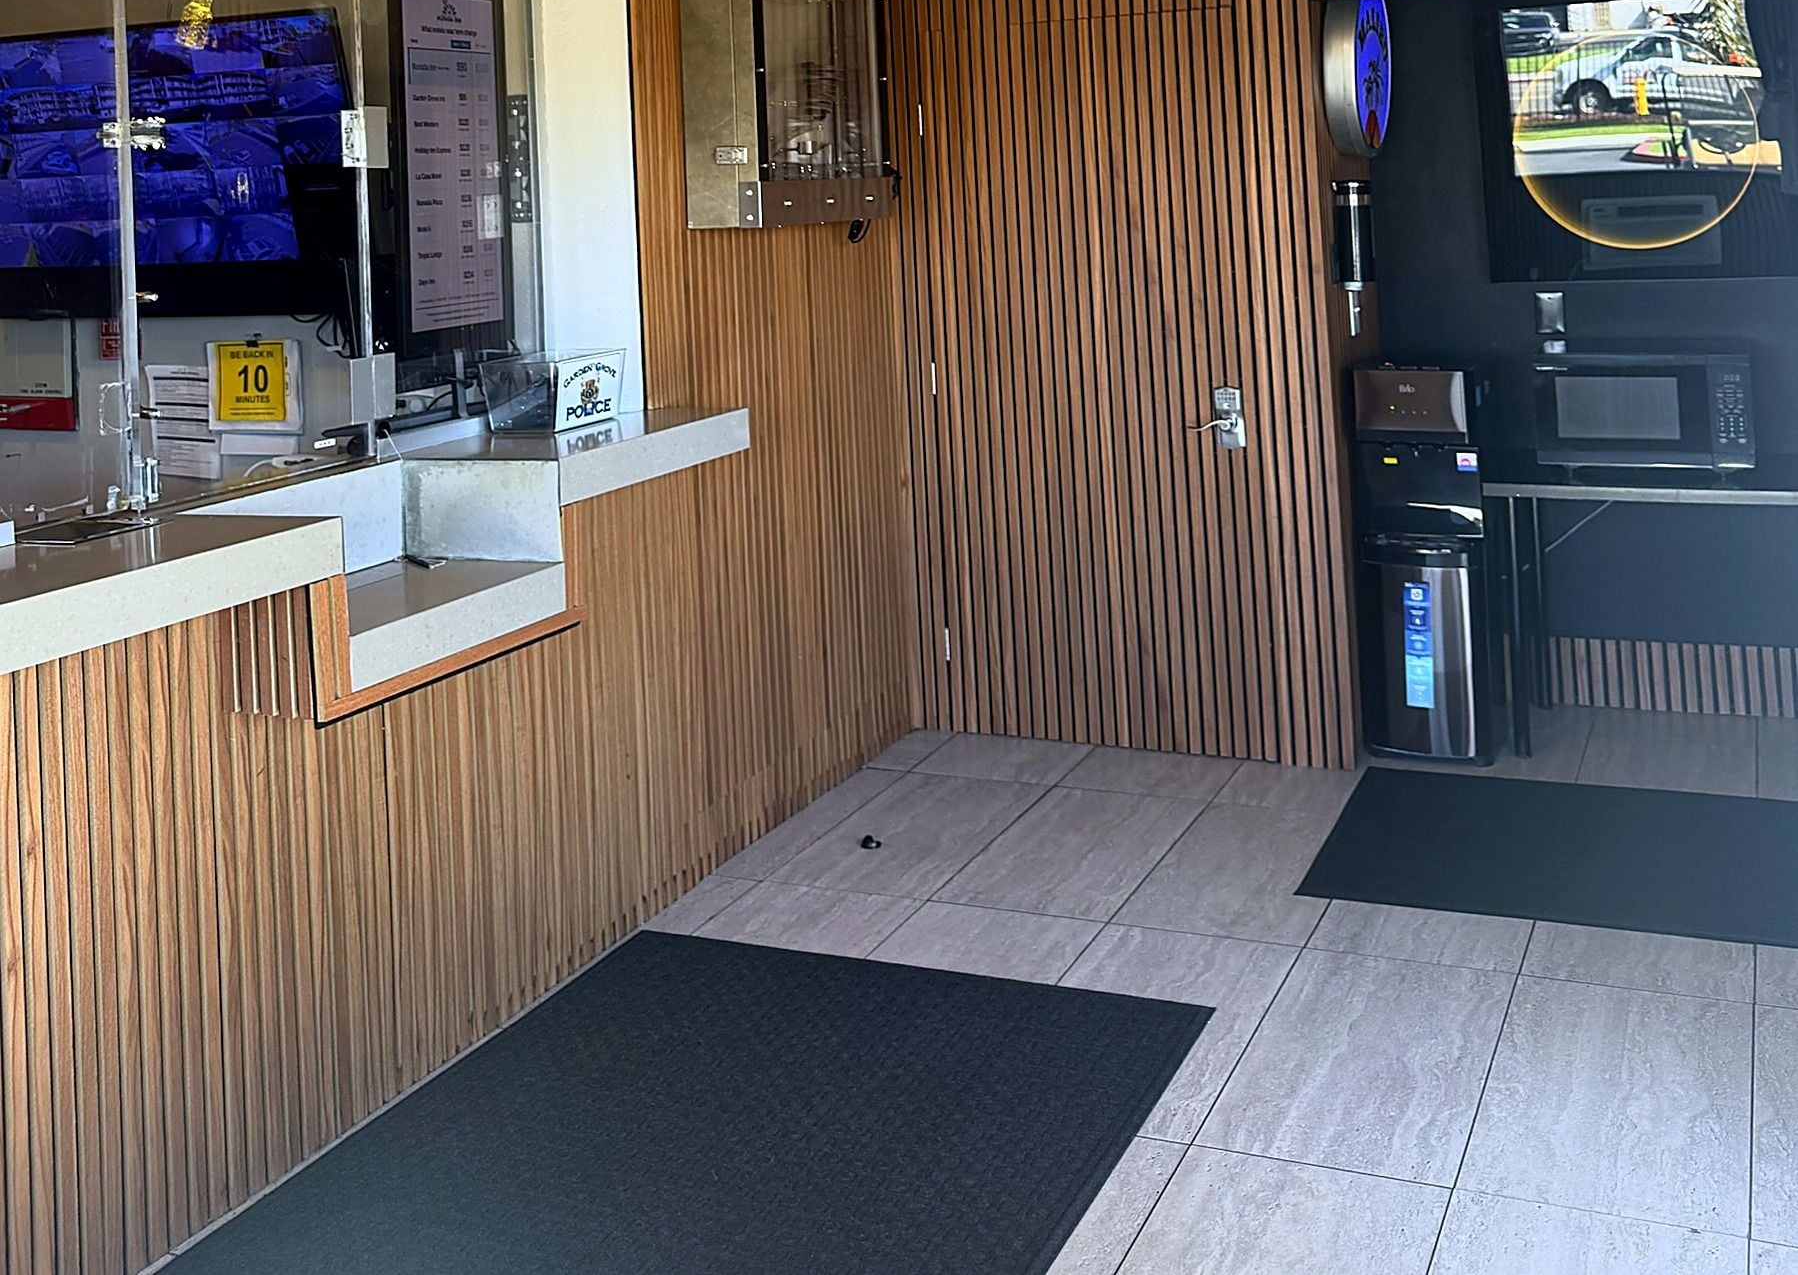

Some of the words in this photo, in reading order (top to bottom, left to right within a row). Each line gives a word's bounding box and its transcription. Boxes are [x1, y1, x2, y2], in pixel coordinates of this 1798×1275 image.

[229, 350, 242, 359] BE
[243, 350, 265, 359] BACK
[266, 349, 274, 358] IN
[238, 364, 269, 393] 10
[235, 394, 271, 404] MINUTES
[566, 398, 612, 421] POLICE
